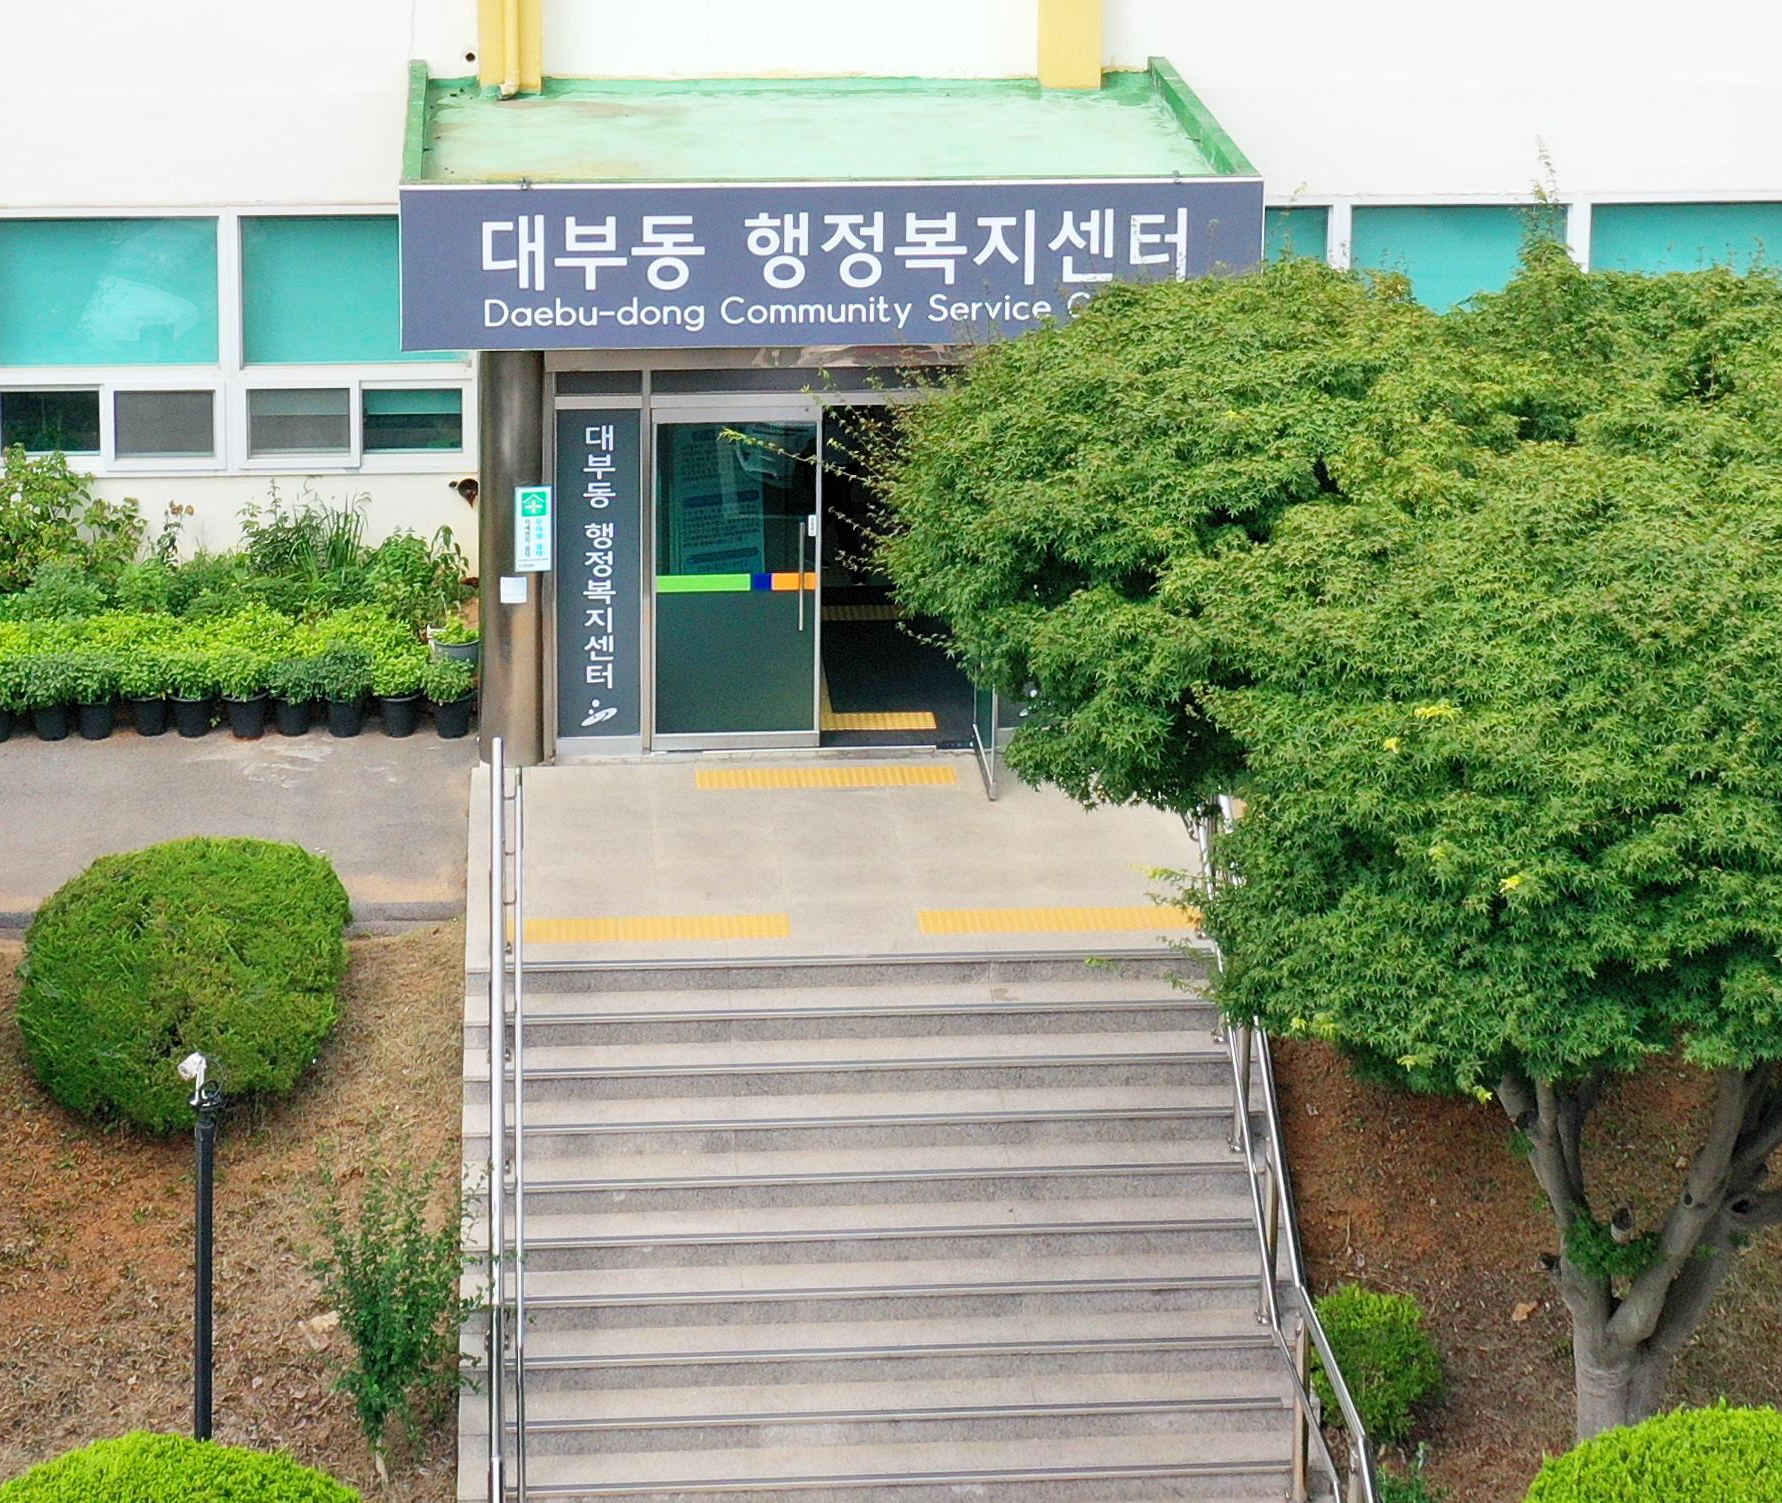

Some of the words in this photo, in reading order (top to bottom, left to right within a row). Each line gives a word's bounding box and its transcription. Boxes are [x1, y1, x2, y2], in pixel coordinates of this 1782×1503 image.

[482, 214, 706, 291] 대부동
[744, 207, 1188, 290] 행정복지센터
[484, 296, 705, 332] Daebu-dong
[720, 294, 912, 329] Community
[928, 293, 1052, 322] Service
[582, 424, 617, 509] 대부동
[582, 522, 617, 690] 행정복지센터
